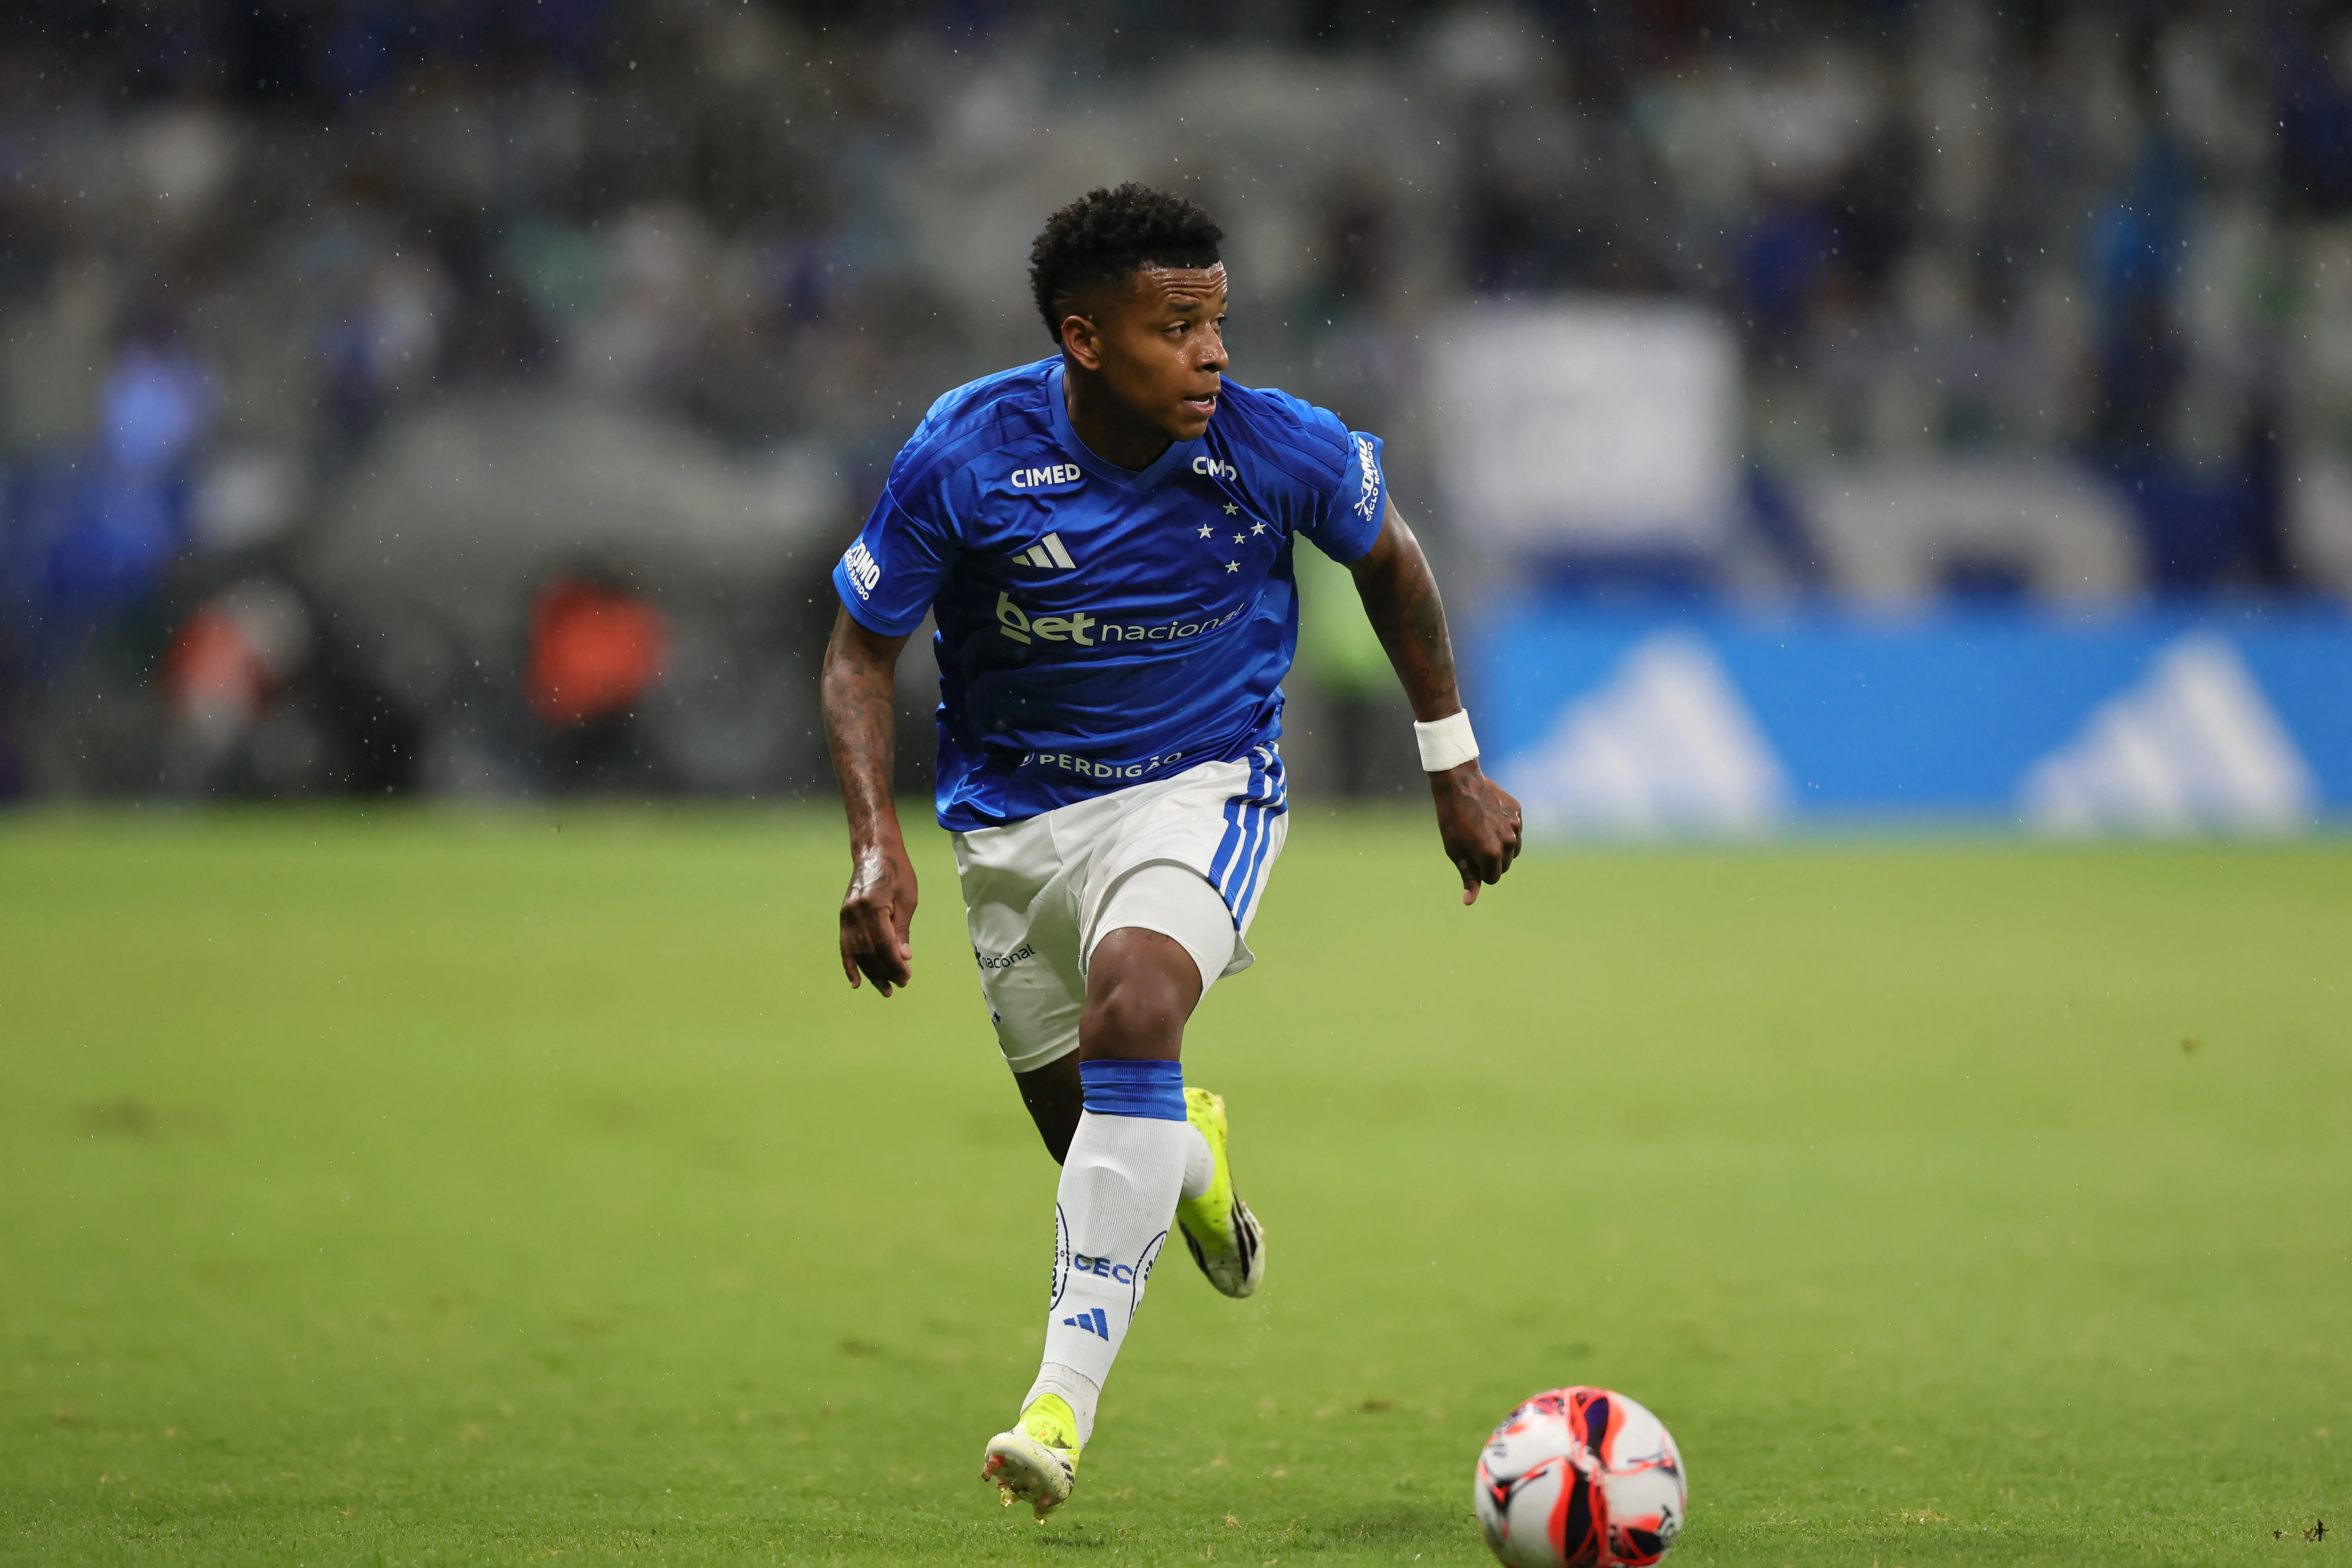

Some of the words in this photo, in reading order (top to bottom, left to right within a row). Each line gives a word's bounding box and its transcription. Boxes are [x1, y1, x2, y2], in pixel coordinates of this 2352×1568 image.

[1011, 464, 1081, 488] CIMED
[1367, 487, 1379, 522] CICLO
[844, 549, 854, 571] CICLO
[996, 591, 1095, 646] bet
[1102, 602, 1245, 641] nacional
[1040, 752, 1182, 778] PERDIGÃO
[982, 944, 1036, 969] nacional
[1074, 1254, 1133, 1284] CEC
